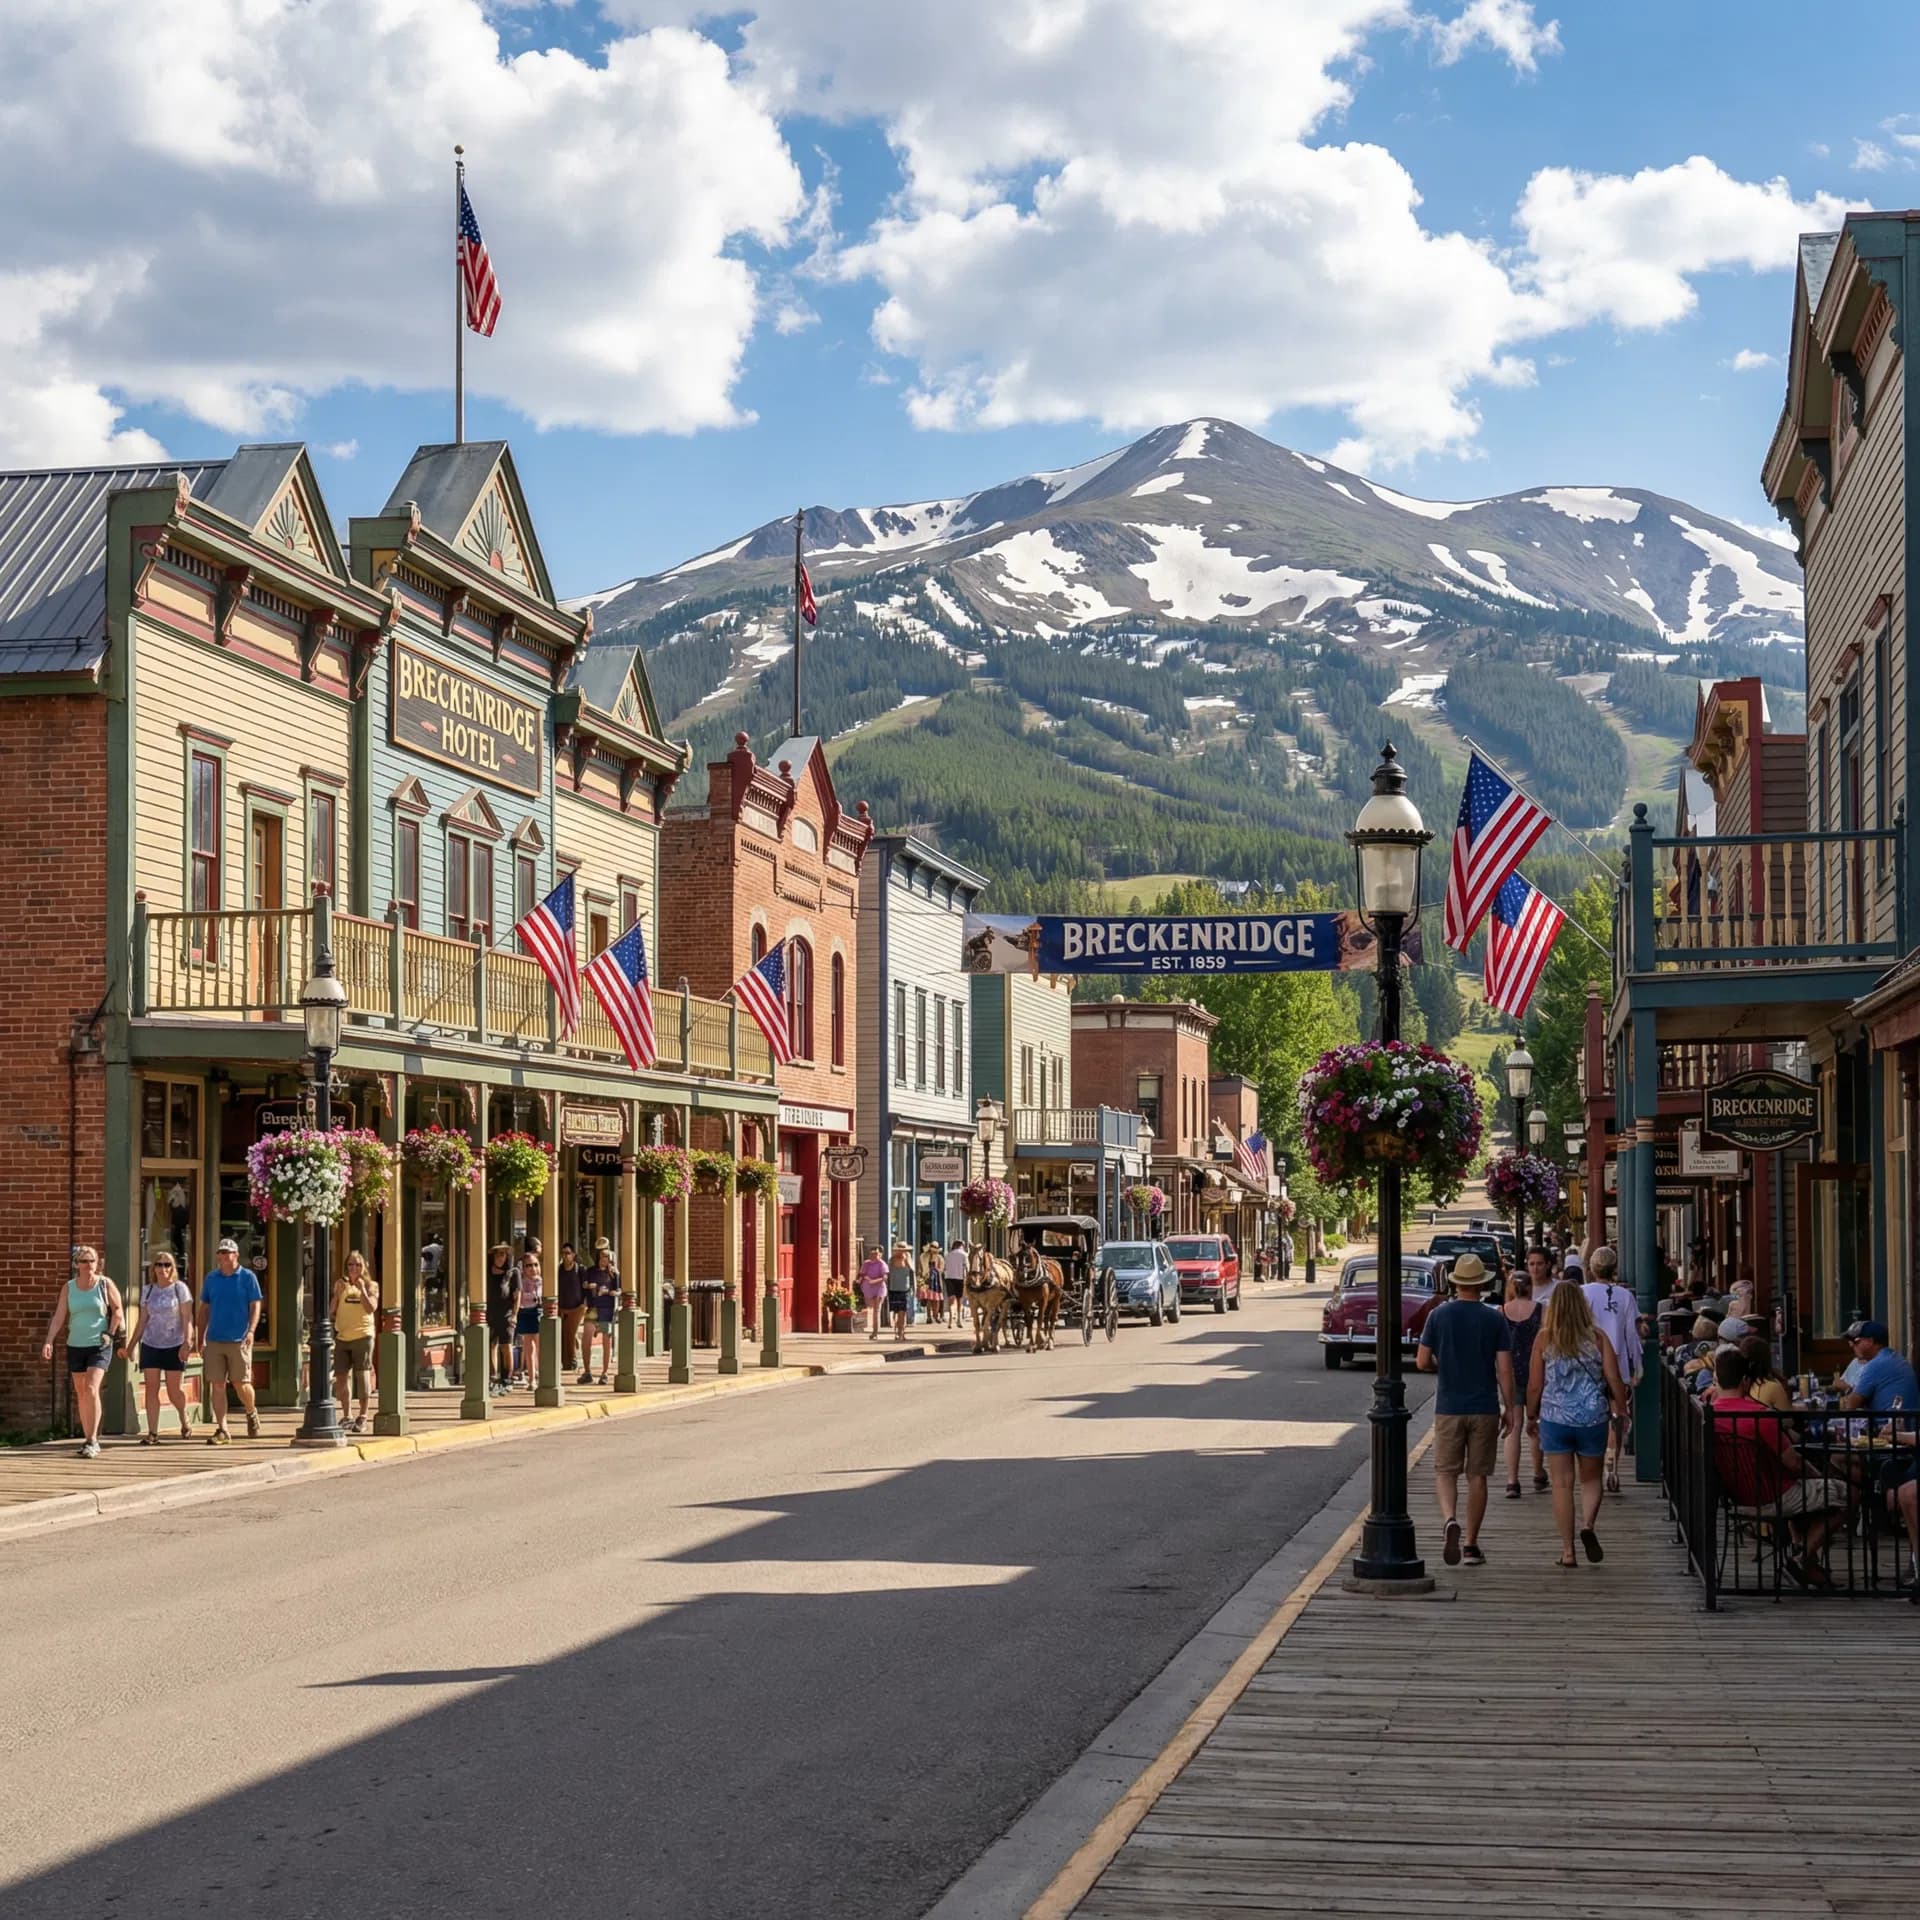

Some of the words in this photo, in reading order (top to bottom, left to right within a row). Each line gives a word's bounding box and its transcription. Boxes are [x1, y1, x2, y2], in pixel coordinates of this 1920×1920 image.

[399, 651, 536, 755] BRECKENRIDGE
[441, 716, 500, 771] HOTEL
[1063, 919, 1315, 960] BRECKENRIDGE
[1151, 956, 1184, 969] EST.
[1189, 955, 1226, 969] 1859
[1711, 1098, 1814, 1117] BRECKENRIDGE
